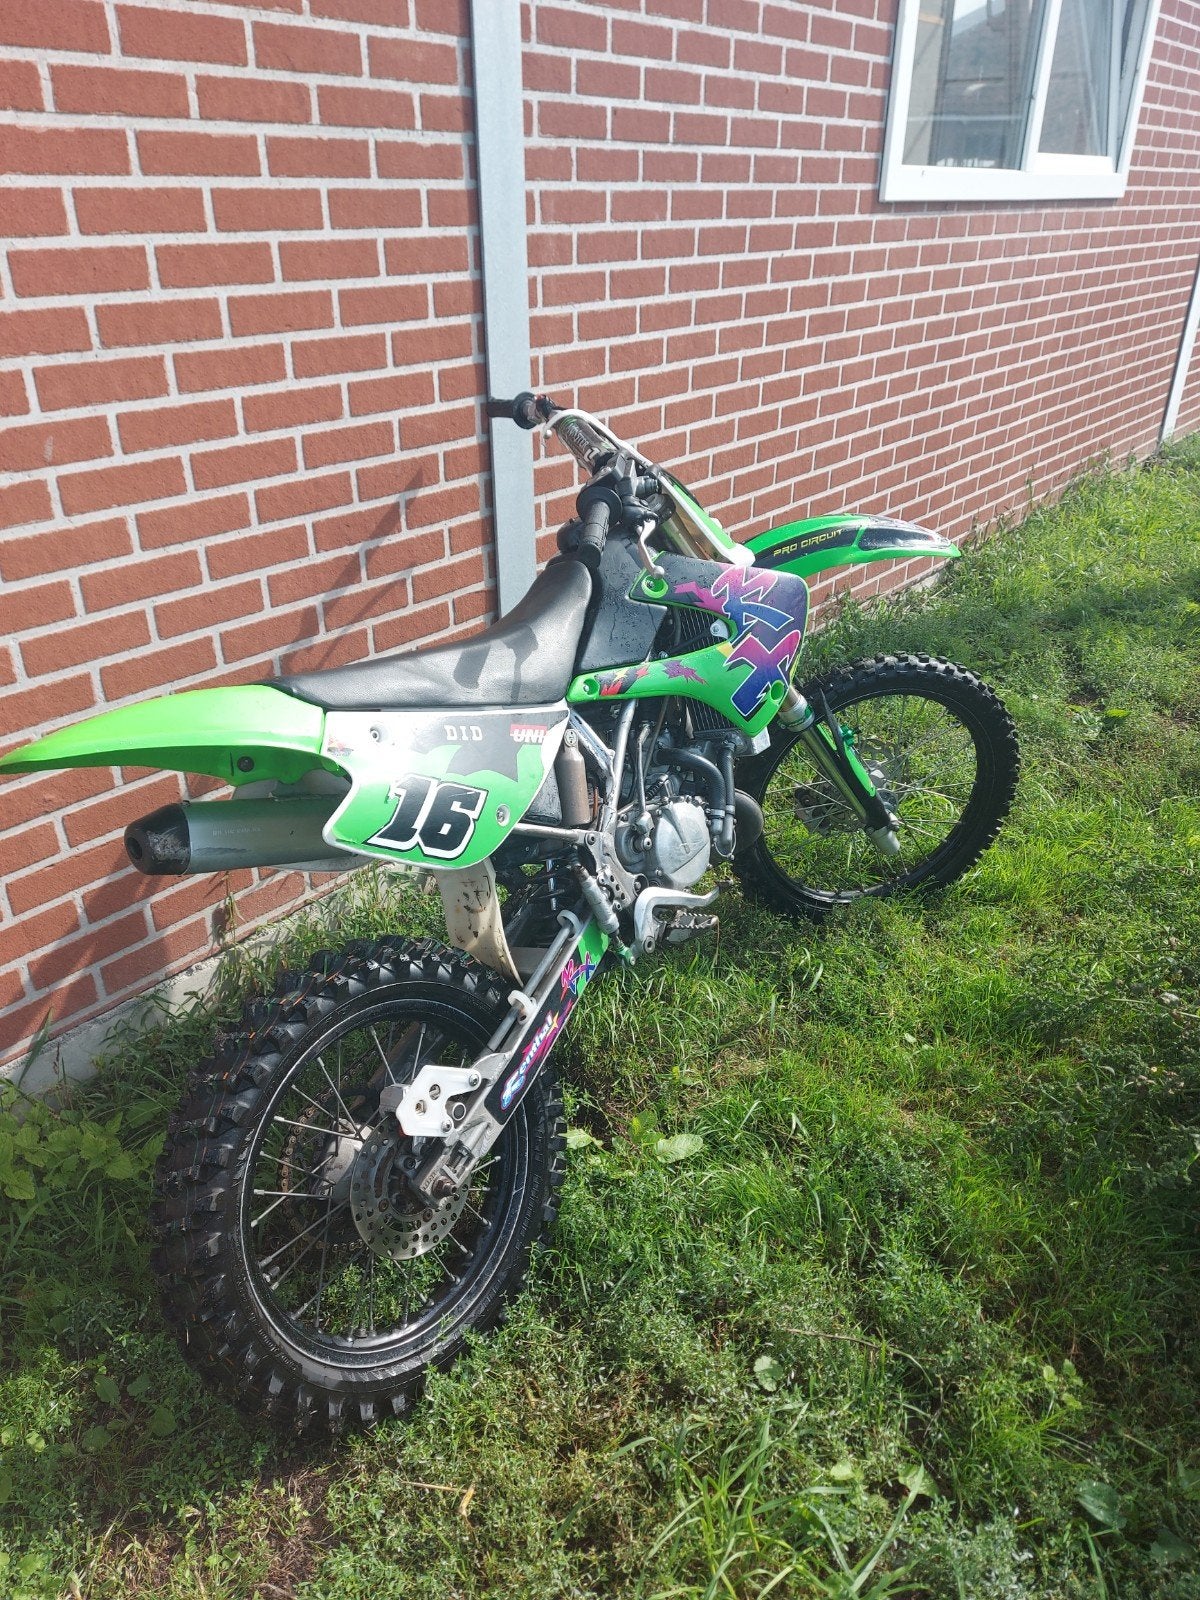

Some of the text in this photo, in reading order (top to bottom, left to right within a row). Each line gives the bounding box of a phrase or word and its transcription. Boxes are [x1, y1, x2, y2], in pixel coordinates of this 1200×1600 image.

[773, 529, 843, 556] PRO CIRCUIT
[362, 774, 489, 861] 16
[501, 1010, 555, 1110] Renthal
